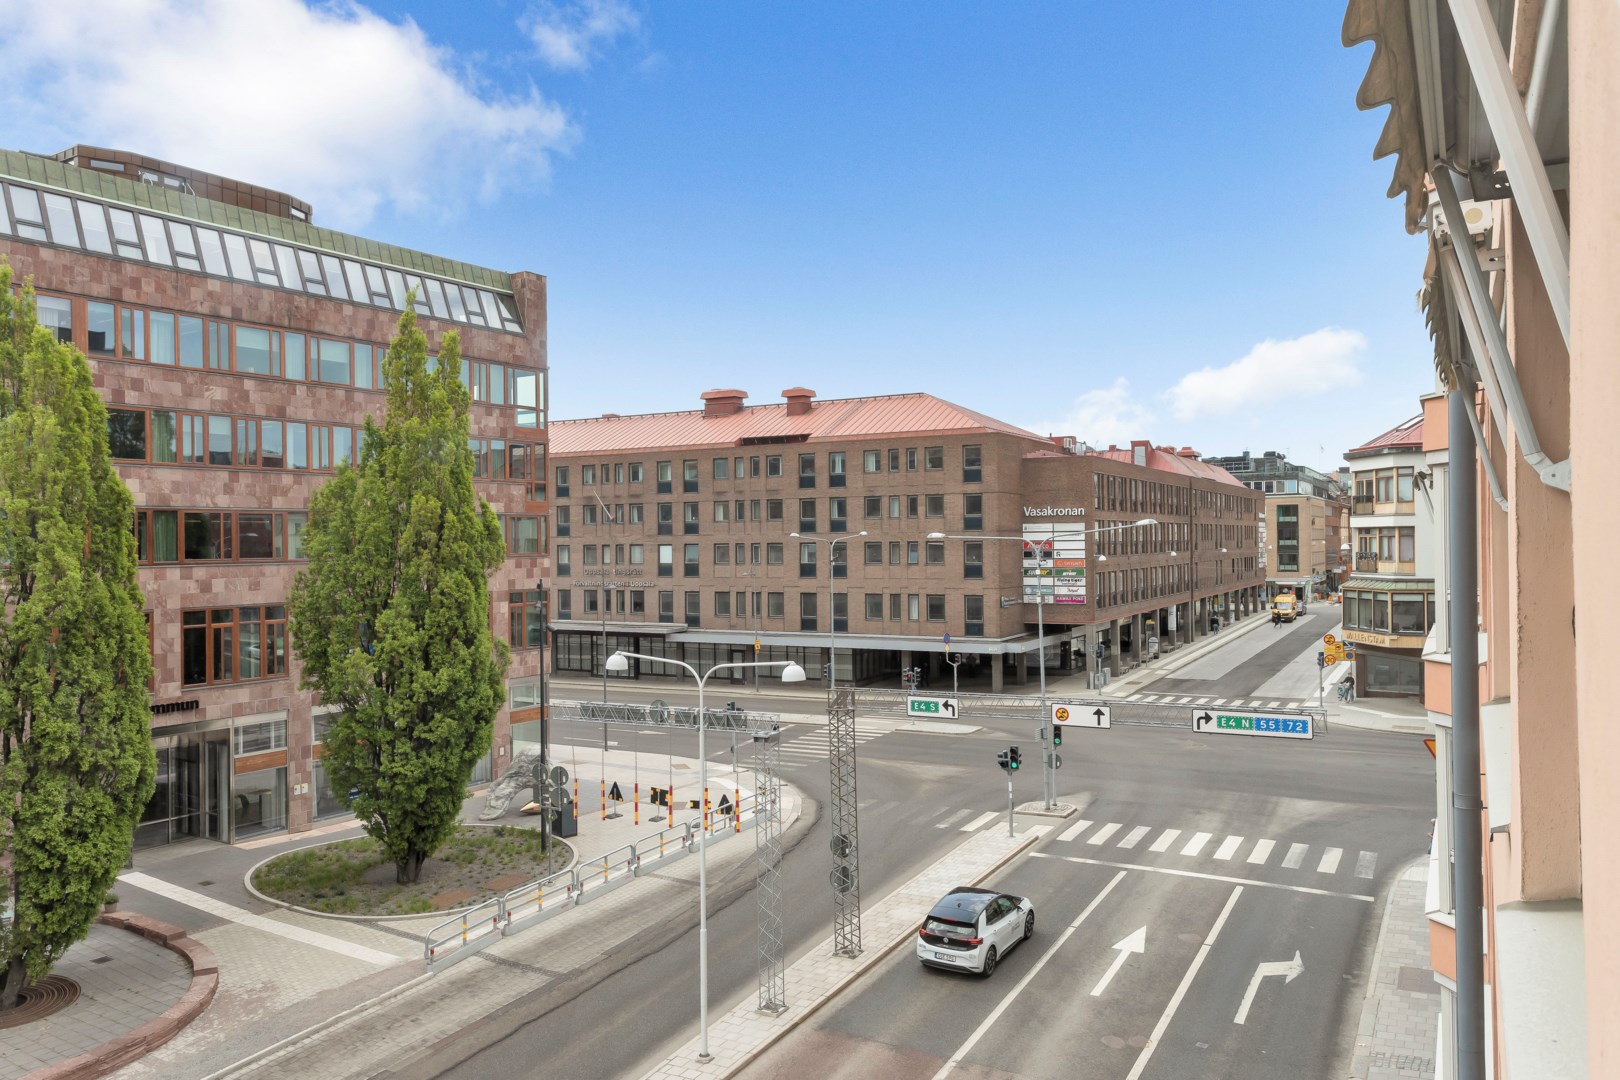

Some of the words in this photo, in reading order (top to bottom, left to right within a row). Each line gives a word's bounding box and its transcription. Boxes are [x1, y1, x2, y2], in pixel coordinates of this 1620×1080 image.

[1023, 505, 1085, 517] Vasakronan
[930, 703, 936, 711] S
[1241, 719, 1249, 728] N
[1260, 720, 1276, 729] 55
[1286, 721, 1303, 731] 72
